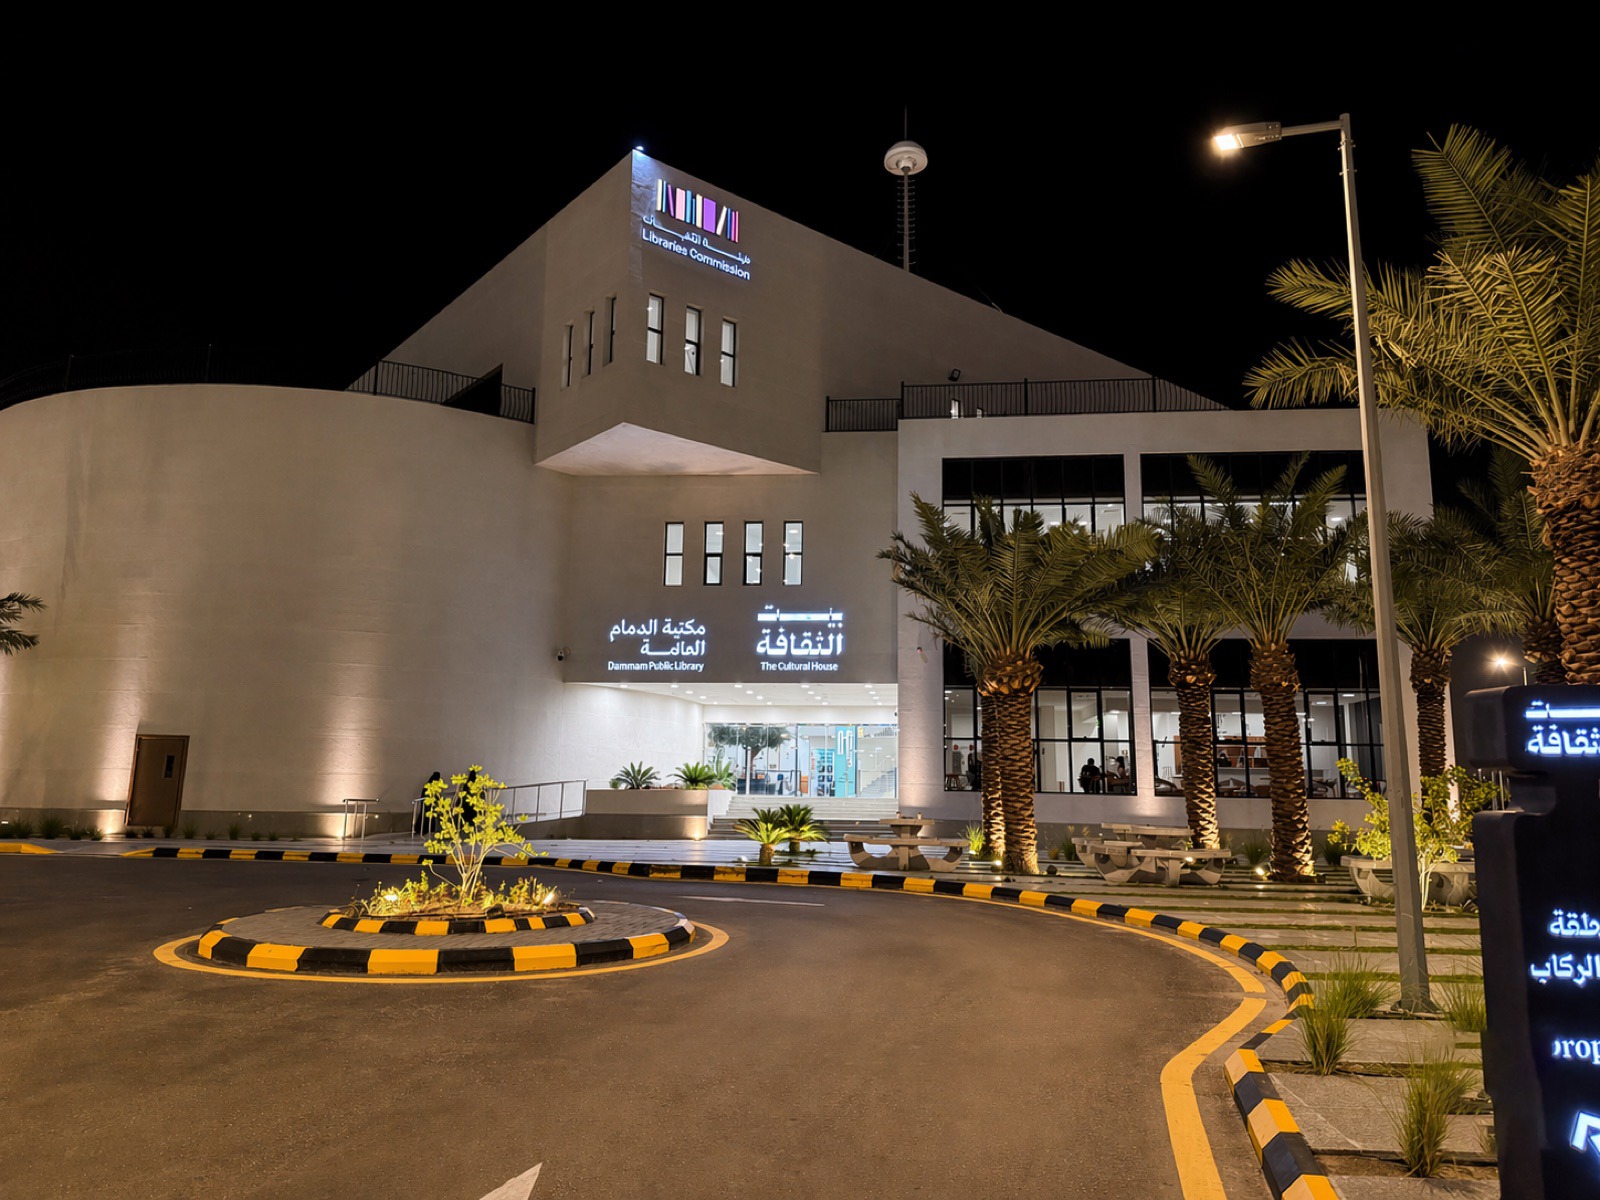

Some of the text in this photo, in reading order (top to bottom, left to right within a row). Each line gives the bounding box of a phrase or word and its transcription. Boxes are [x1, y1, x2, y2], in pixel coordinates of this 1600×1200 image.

[642, 228, 750, 280] Libraries Commission
[610, 618, 658, 642] الدمام
[756, 627, 844, 655] الثقافة
[640, 638, 705, 656] العامة
[607, 661, 705, 673] Dammam Public Library
[760, 661, 839, 671] The Cultural House
[1526, 724, 1600, 755] ثقافة
[1549, 908, 1600, 936] طقة
